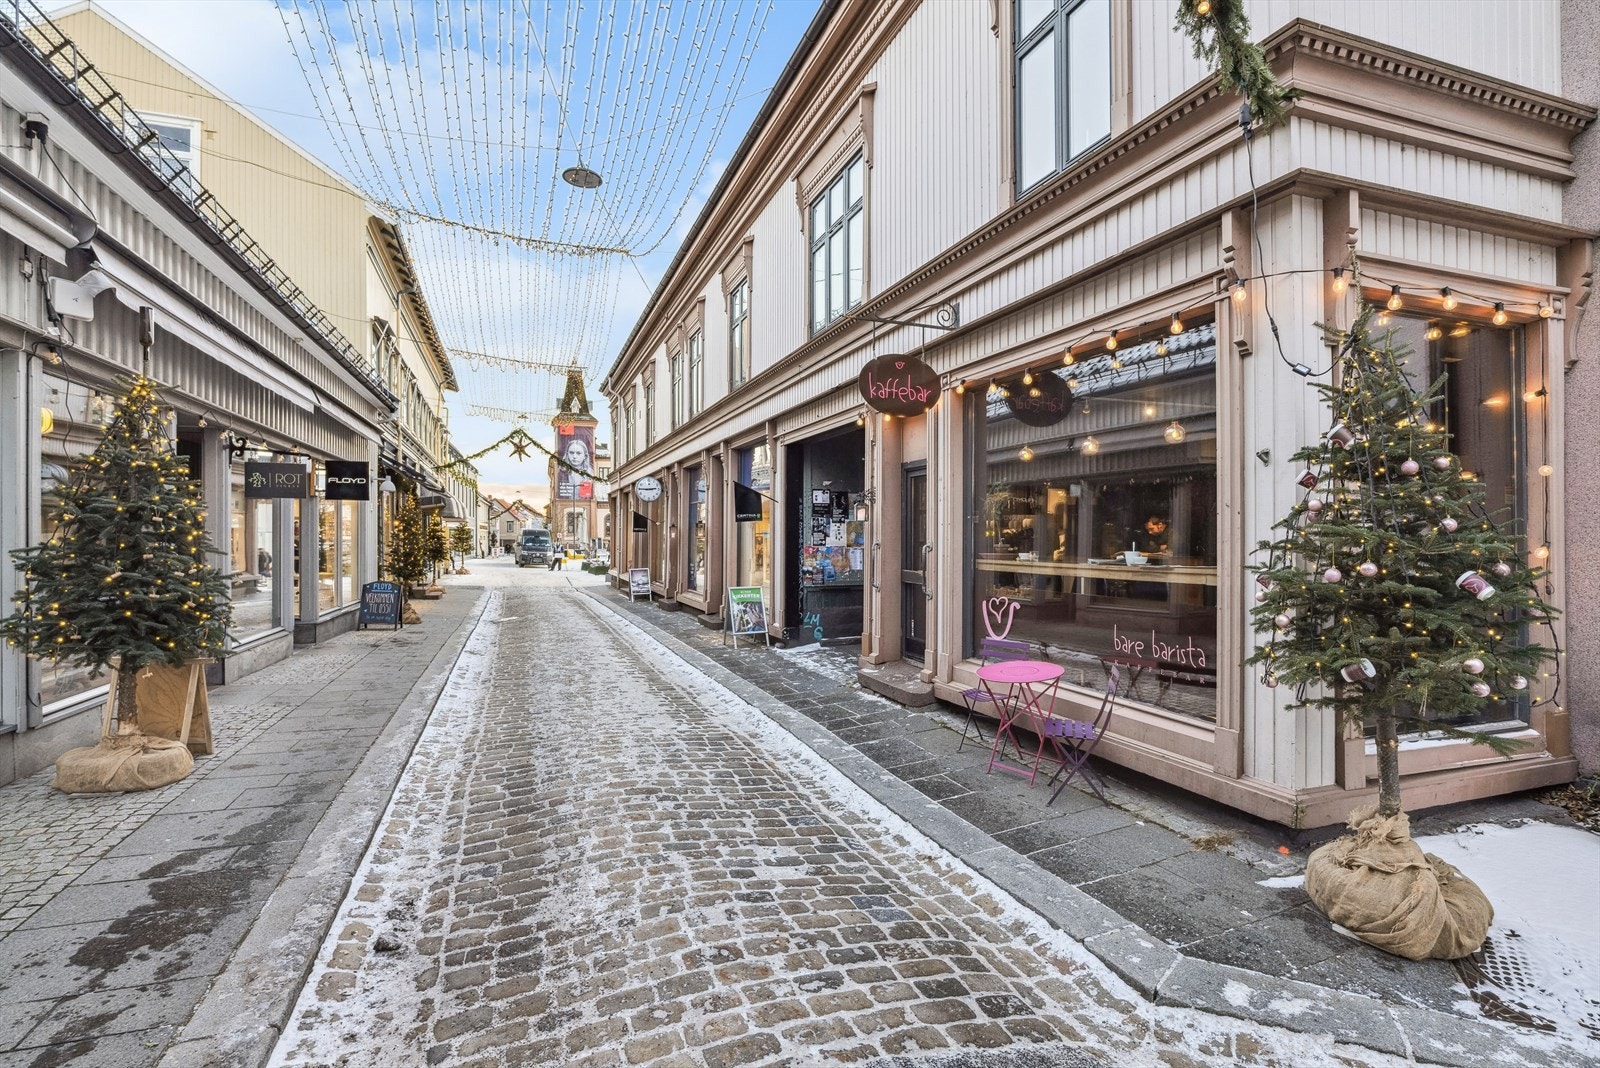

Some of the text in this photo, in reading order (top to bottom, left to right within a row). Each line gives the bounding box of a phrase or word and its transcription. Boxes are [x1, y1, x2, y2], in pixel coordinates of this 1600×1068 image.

[868, 372, 932, 403] kaffebar
[275, 473, 304, 484] ROT
[373, 582, 393, 590] FLOYD
[369, 603, 377, 613] TIL
[1113, 623, 1206, 668] bare barista
